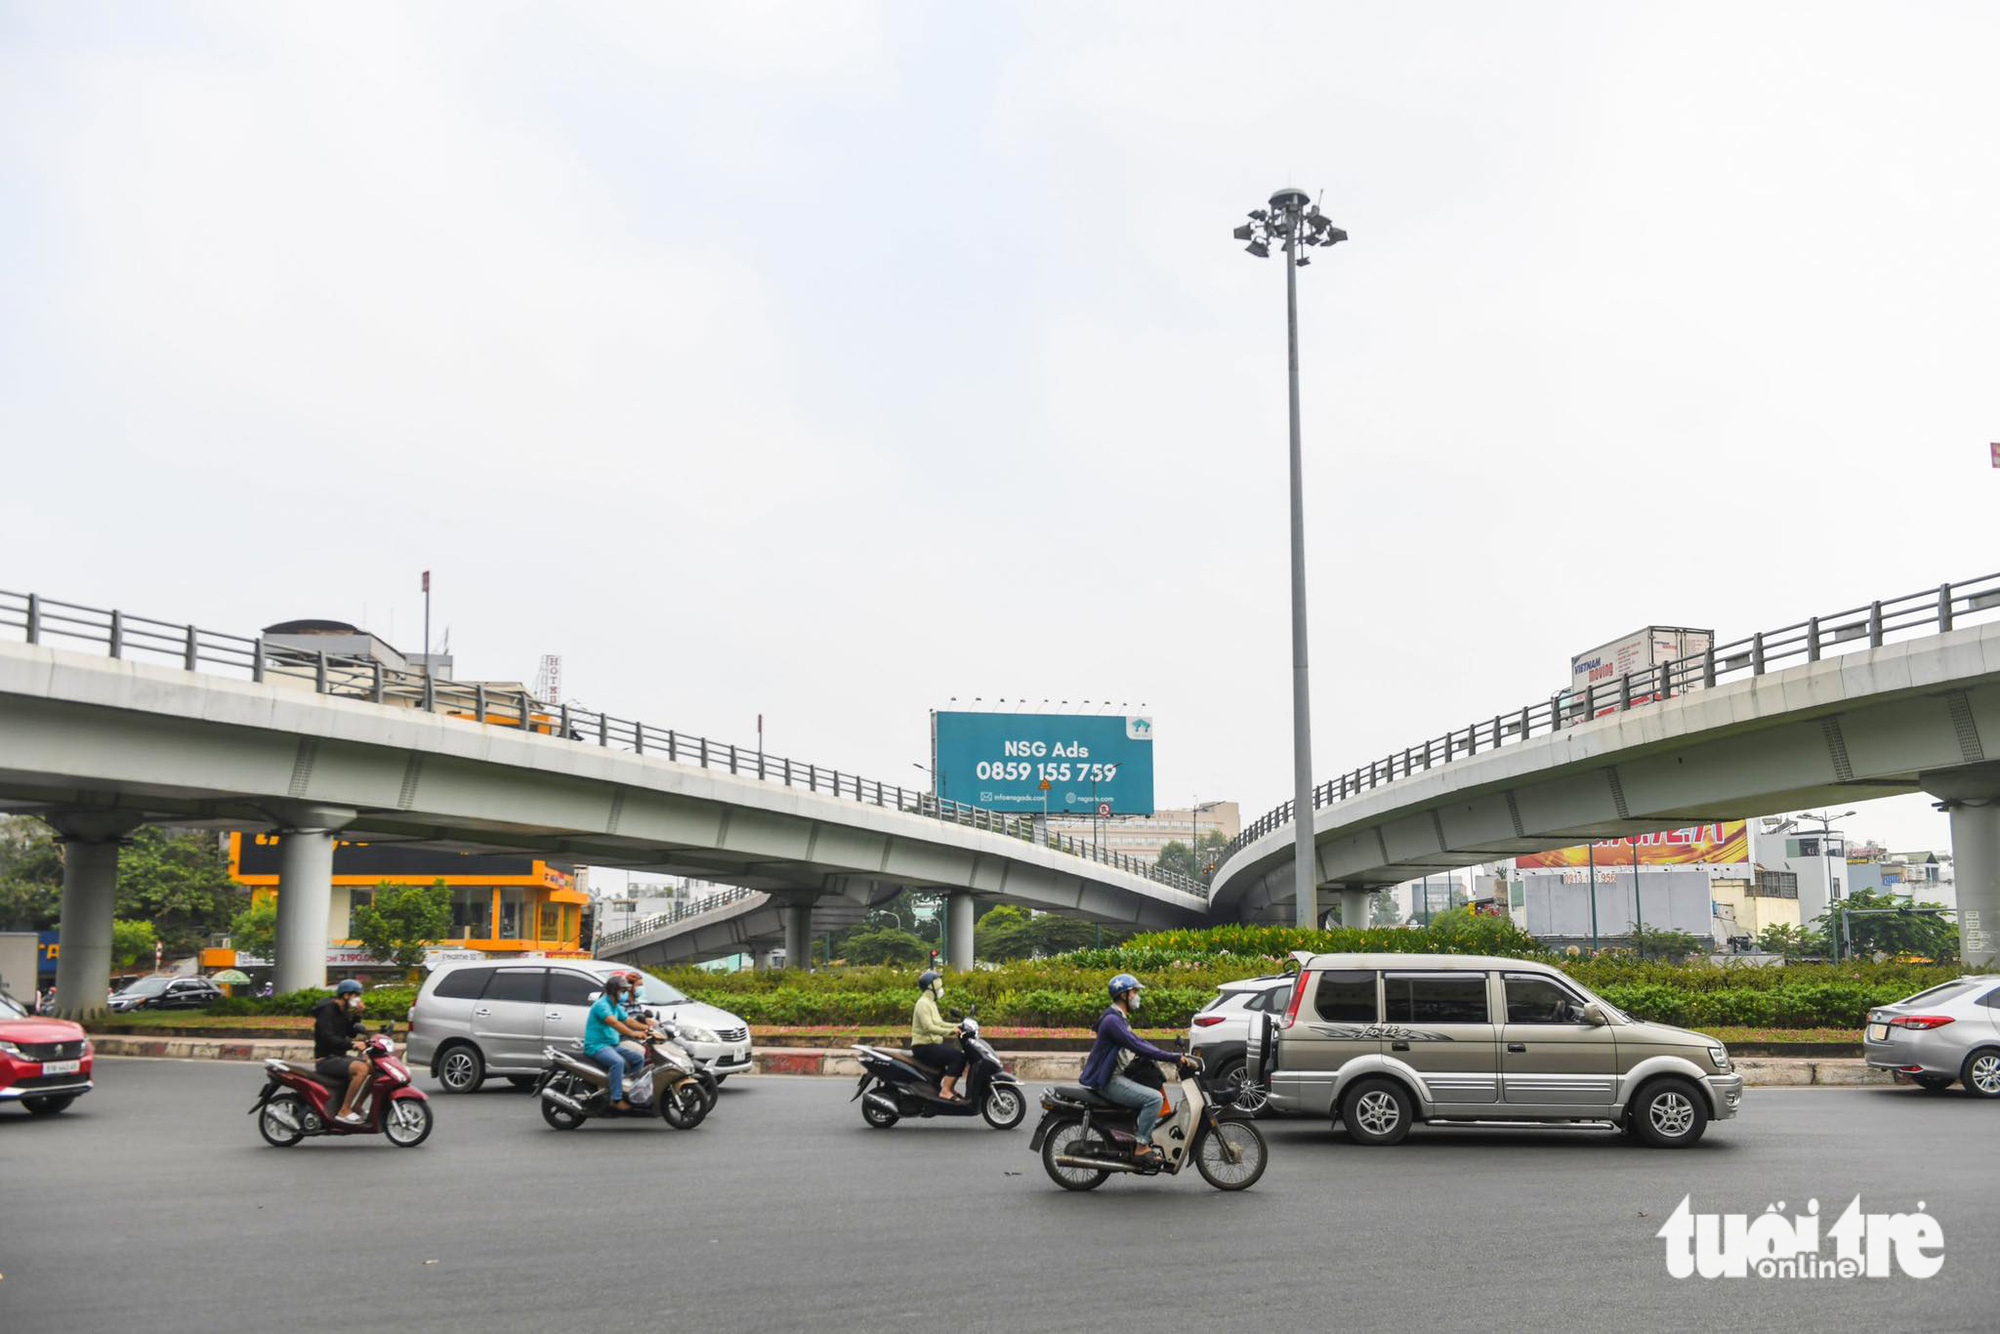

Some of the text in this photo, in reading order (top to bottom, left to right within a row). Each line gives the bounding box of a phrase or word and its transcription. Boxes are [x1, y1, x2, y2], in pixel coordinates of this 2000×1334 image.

[1574, 657, 1601, 674] VIETNAM
[1588, 662, 1614, 683] moving
[1005, 740, 1090, 759] NSG Ads
[976, 761, 1117, 783] 0859 155 759
[1352, 1024, 1412, 1040] Jolie
